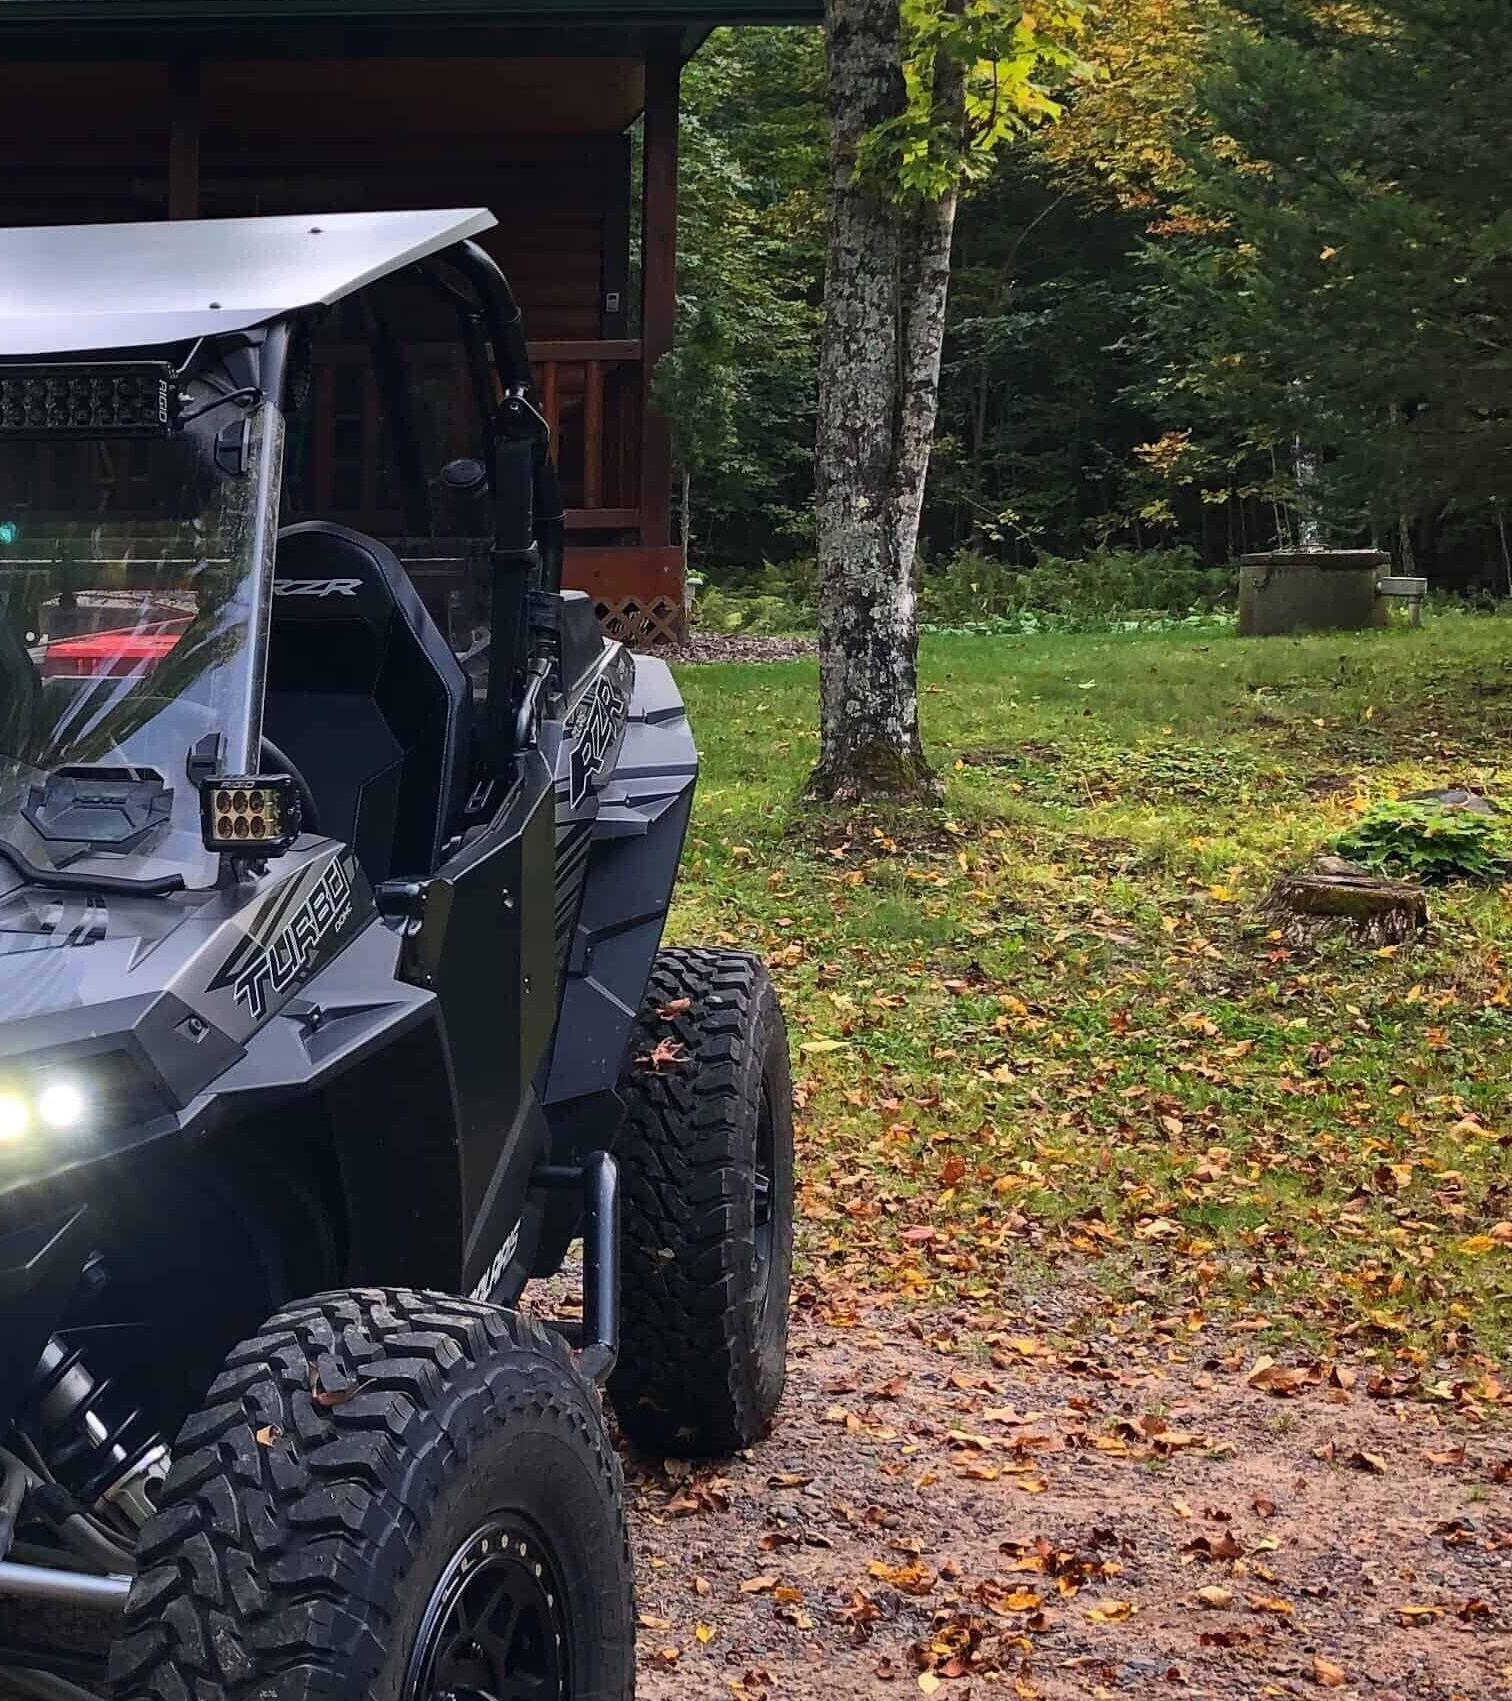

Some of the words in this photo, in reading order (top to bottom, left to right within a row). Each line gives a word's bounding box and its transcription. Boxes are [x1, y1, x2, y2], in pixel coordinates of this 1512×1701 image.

[158, 379, 168, 423] RIGID
[569, 673, 624, 810] RZR
[232, 855, 351, 1018] TURBO
